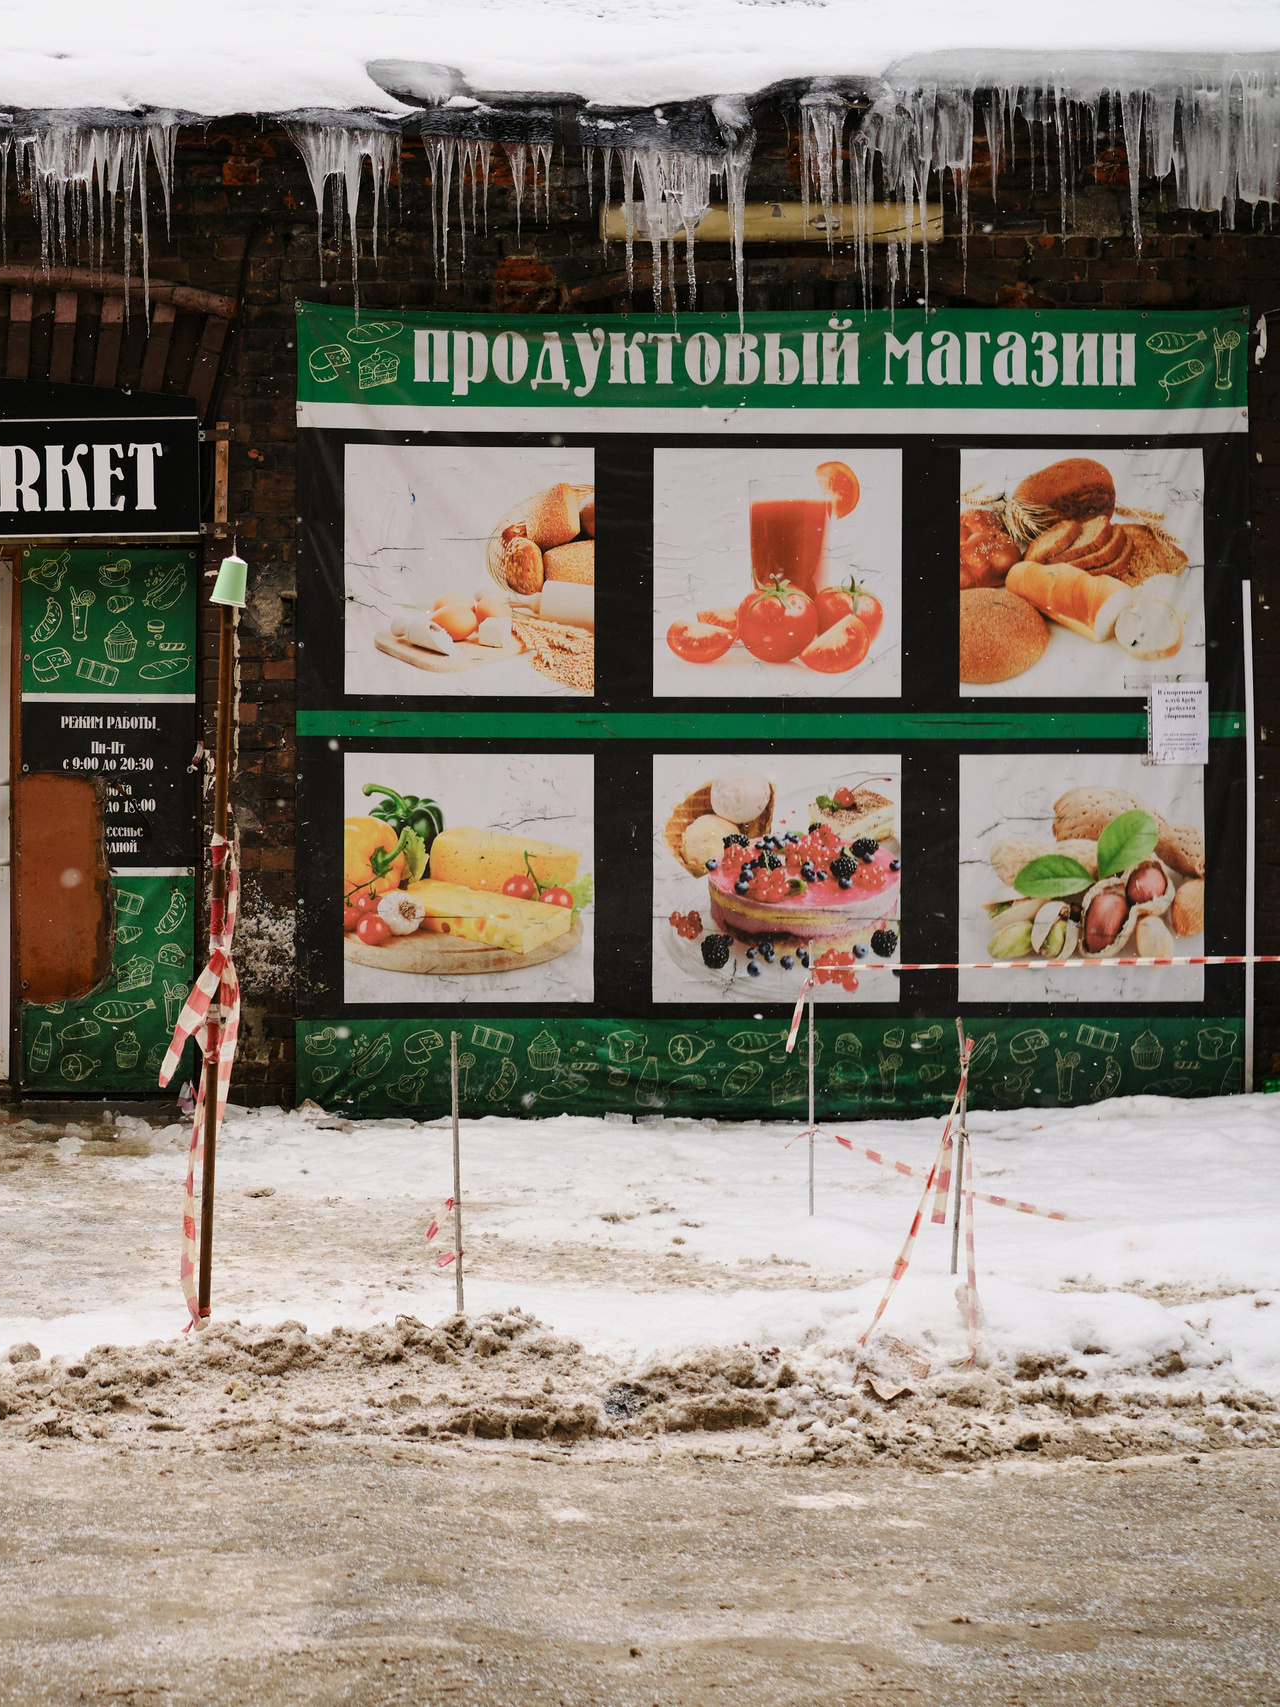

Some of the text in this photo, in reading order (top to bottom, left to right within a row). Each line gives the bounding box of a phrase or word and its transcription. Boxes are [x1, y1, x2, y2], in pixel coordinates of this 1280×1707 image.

[61, 715, 157, 730] РЕЖИМ РАБОТЫ
[62, 756, 154, 771] с 9:00 до 20:30
